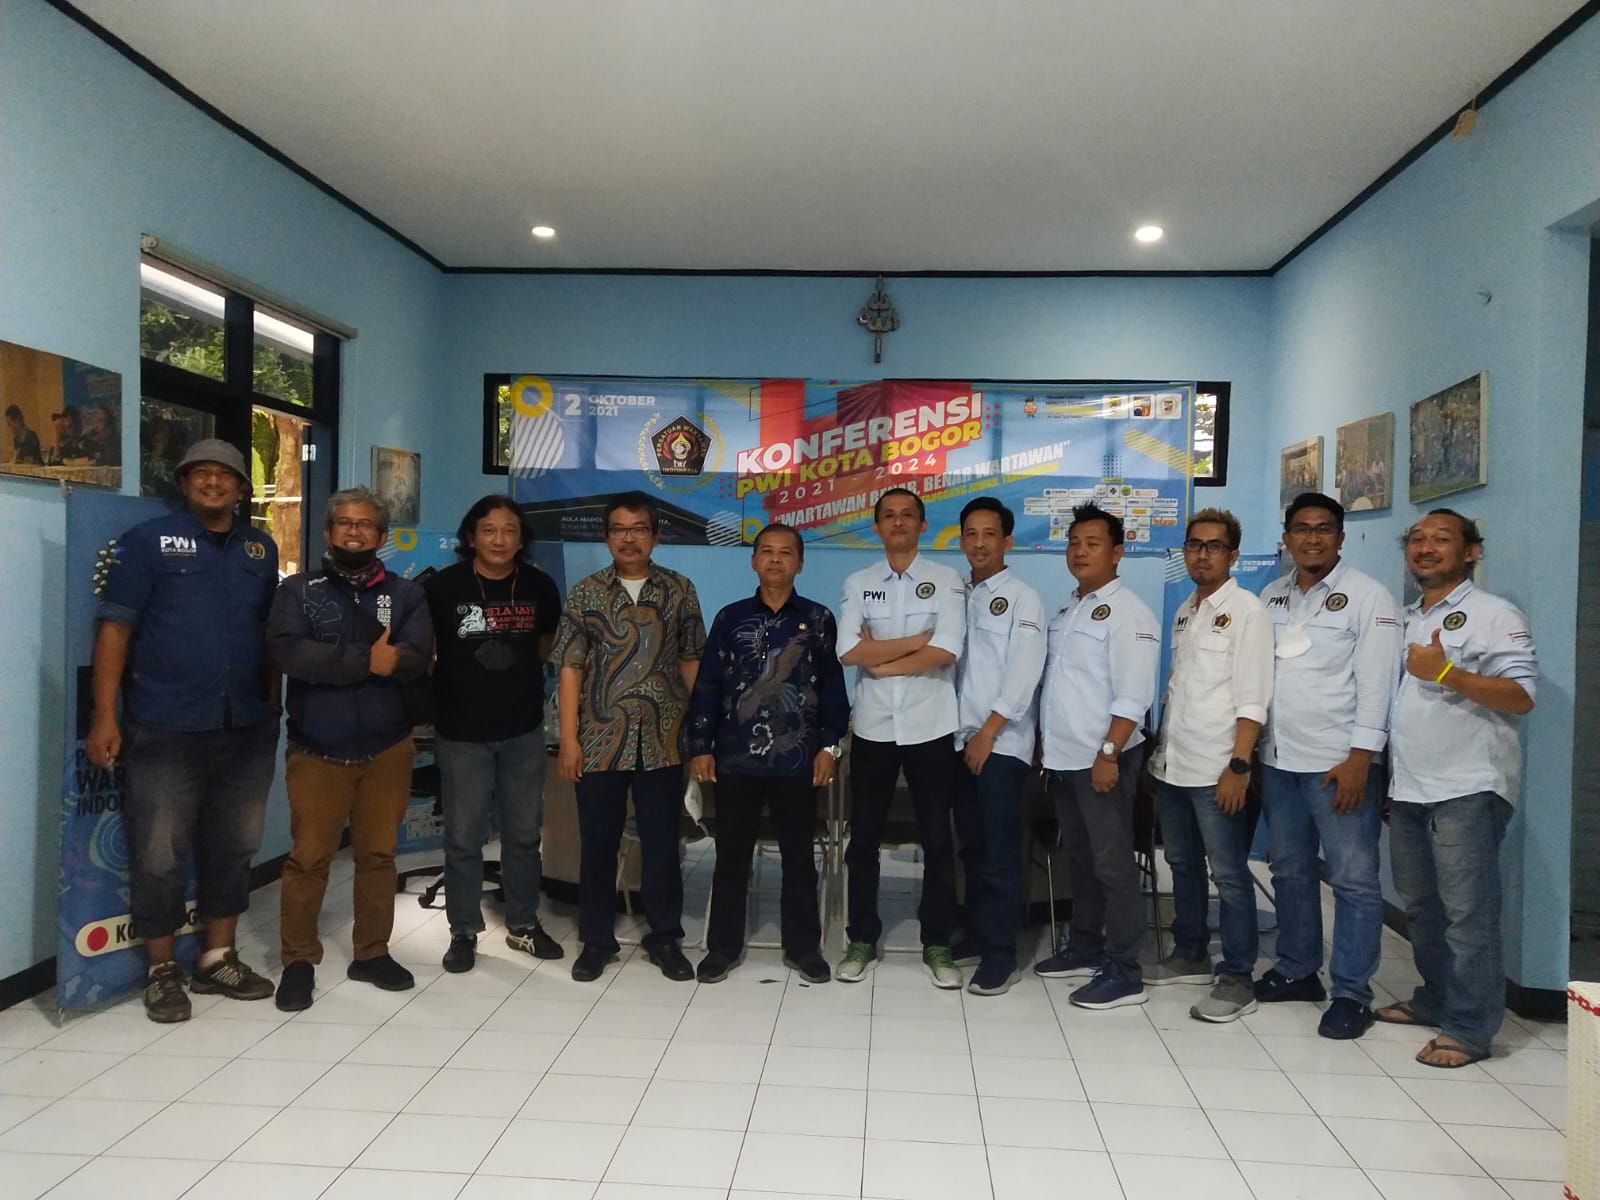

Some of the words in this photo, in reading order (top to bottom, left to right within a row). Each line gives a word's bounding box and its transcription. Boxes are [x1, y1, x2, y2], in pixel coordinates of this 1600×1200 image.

[563, 393, 582, 416] 2
[588, 394, 656, 406] OKTOBER
[588, 406, 619, 417] 2021
[737, 392, 982, 478] KONFERENSI
[736, 467, 792, 498] PWI
[799, 447, 875, 483] KOTA
[881, 420, 982, 463] BOGOR
[778, 479, 835, 504] 2021
[874, 453, 937, 480] 2024
[160, 535, 197, 549] PWI
[863, 590, 886, 601] PWI
